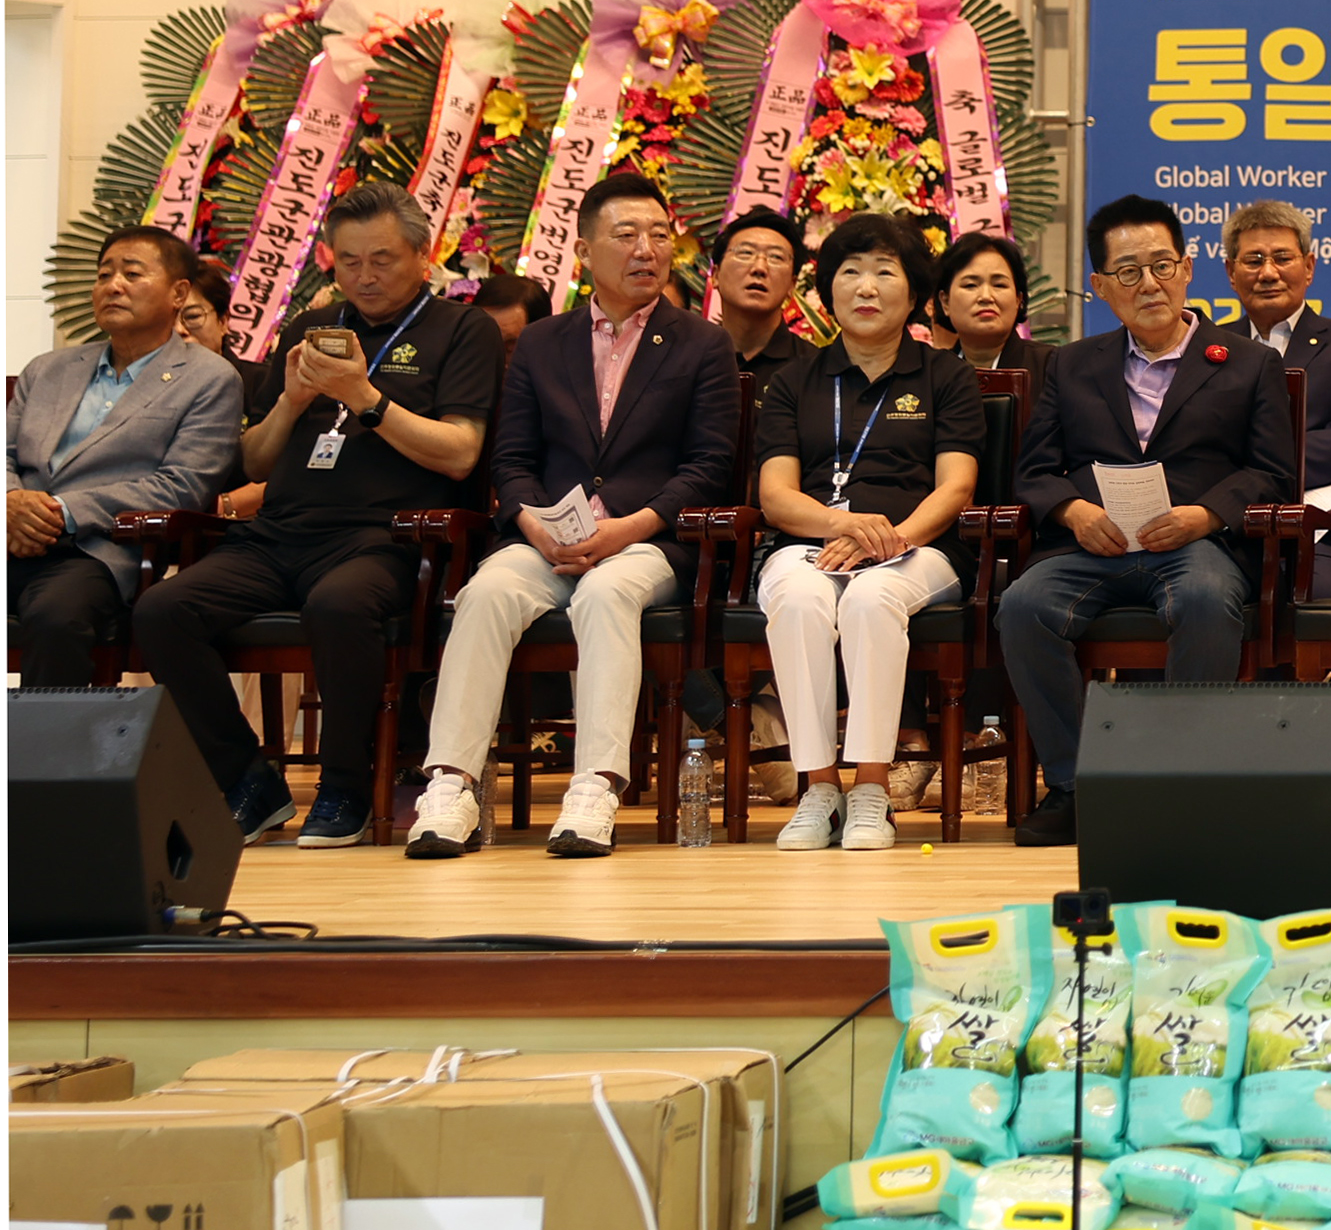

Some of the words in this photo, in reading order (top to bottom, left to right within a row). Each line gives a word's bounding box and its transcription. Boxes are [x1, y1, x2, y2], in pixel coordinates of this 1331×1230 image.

[943, 88, 984, 116] 축
[741, 126, 792, 200] 진도
[949, 129, 993, 206] 글로벌
[1154, 164, 1231, 190] Global
[1237, 164, 1328, 189] Worker
[1171, 202, 1230, 225] lobal
